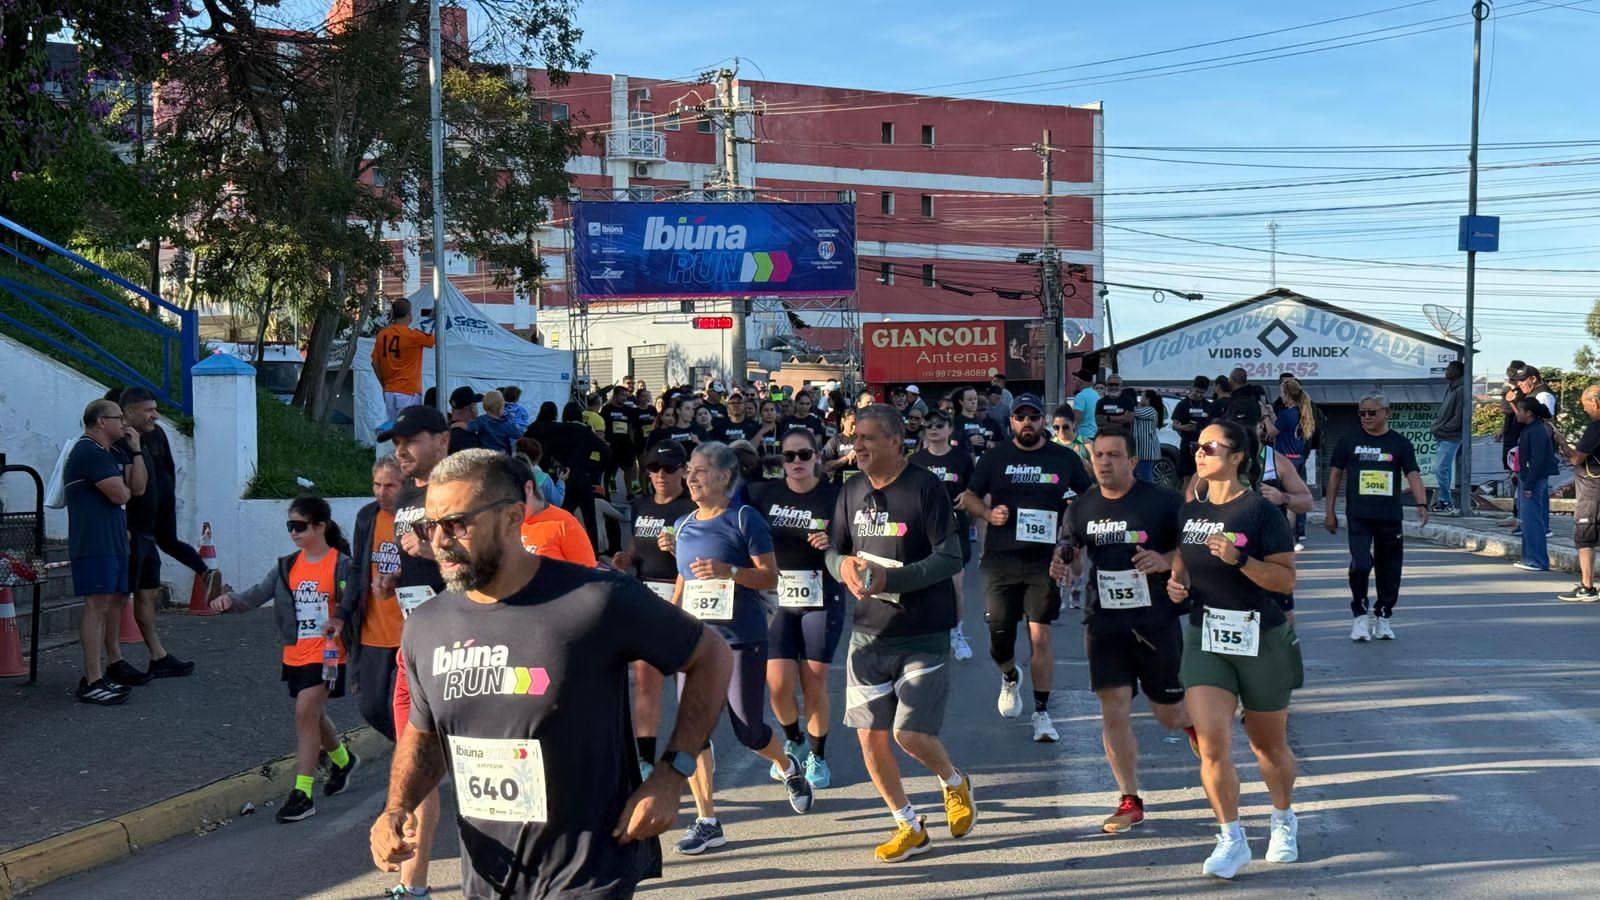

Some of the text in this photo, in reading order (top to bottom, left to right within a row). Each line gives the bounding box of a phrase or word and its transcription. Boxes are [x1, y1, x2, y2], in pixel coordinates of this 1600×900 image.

[643, 216, 747, 250] Ibiúna
[668, 252, 743, 284] RUN
[872, 327, 997, 348] GIANCOLI
[1138, 306, 1279, 368] Vidraçaria
[1284, 305, 1425, 366] ALVORADA
[382, 335, 400, 359] 14
[1208, 346, 1349, 359] VIDROS BLINDEX
[916, 350, 998, 364] Antenas
[1005, 463, 1042, 475] Ibiúna
[769, 503, 812, 520] Ibiúna
[858, 522, 887, 537] RUN
[1026, 523, 1046, 535] 198
[1086, 518, 1127, 535] Ibiúna
[380, 543, 398, 554] GPS
[298, 581, 319, 591] GPS
[786, 587, 810, 598] 210
[1108, 588, 1134, 600] 153
[1213, 629, 1242, 644] 135
[432, 639, 509, 676] Ibiúna
[444, 667, 506, 701] RUN
[456, 745, 484, 758] Ibiúna
[469, 776, 519, 801] 640
